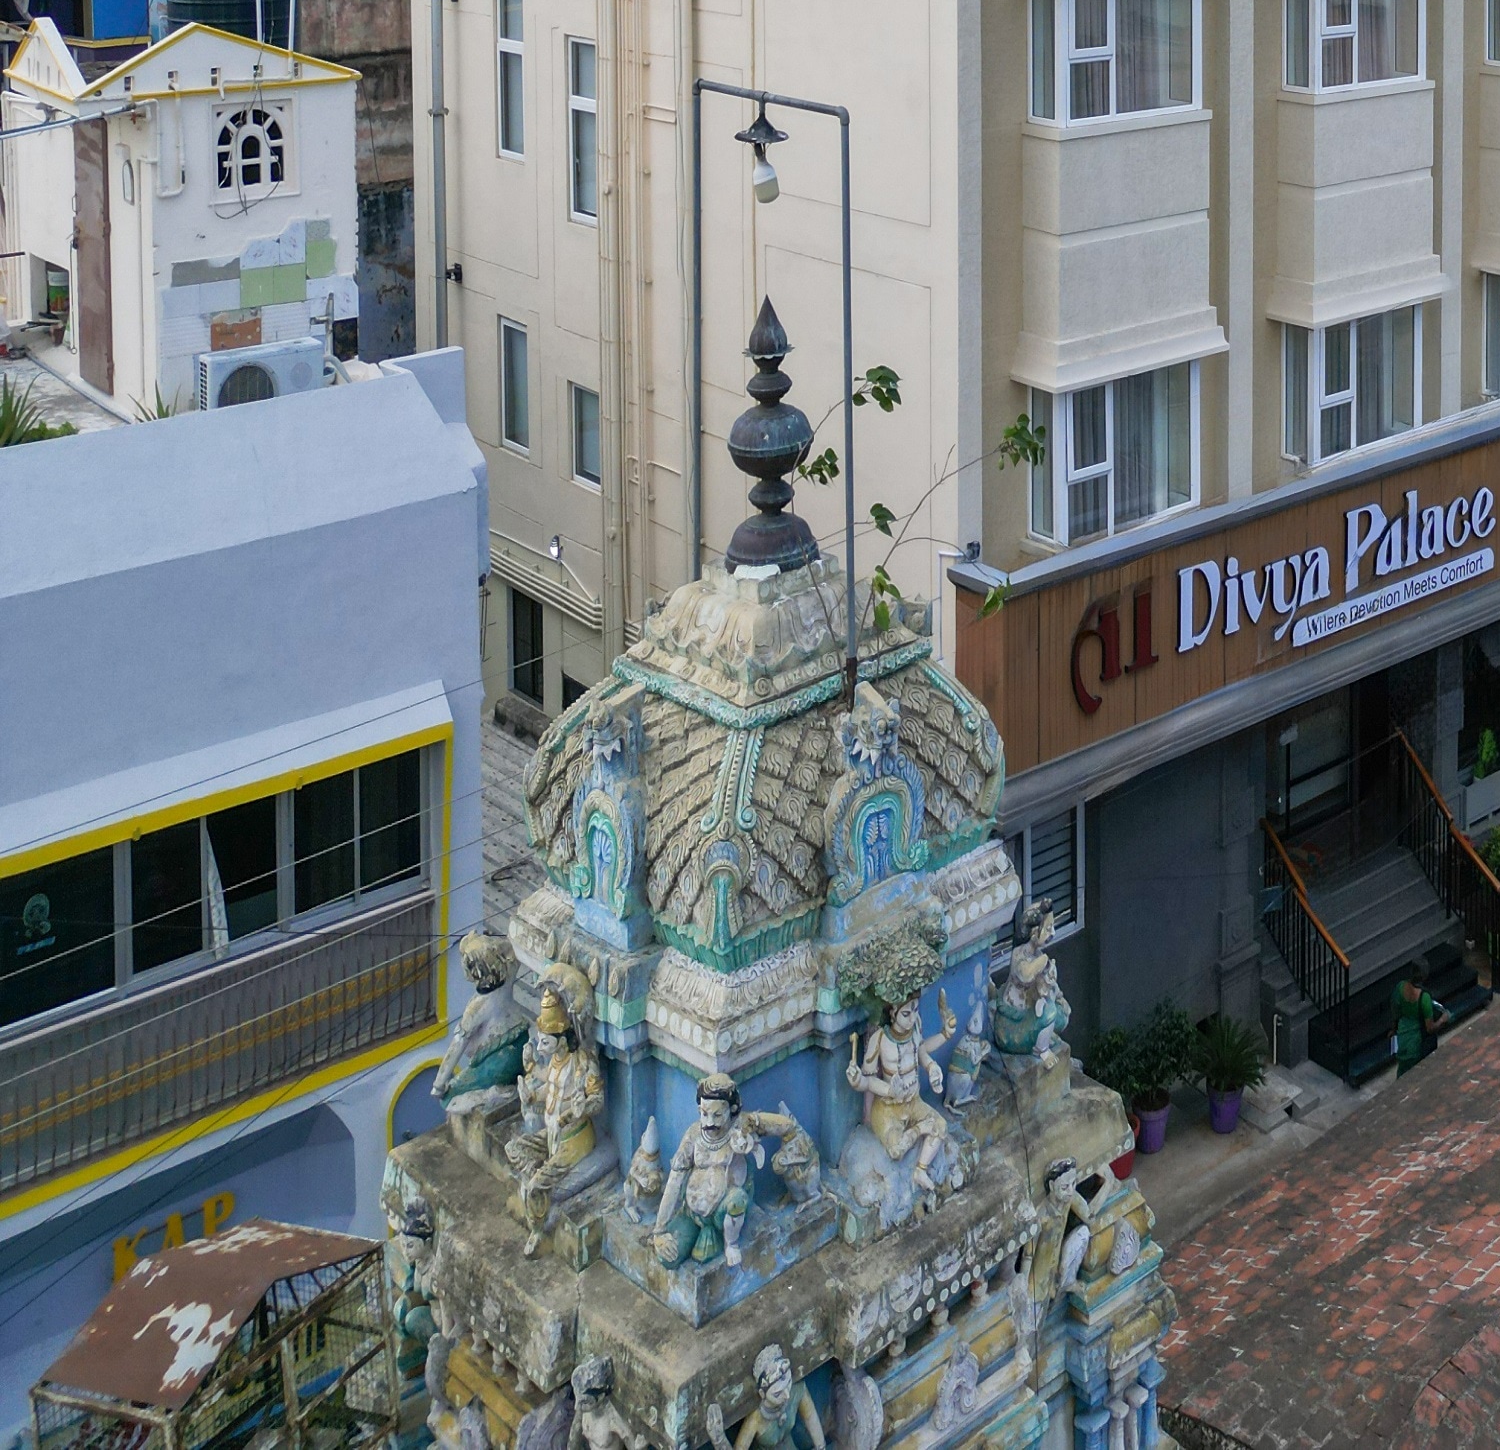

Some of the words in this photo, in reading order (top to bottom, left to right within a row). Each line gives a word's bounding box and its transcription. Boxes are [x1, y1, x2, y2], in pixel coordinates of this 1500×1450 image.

[1177, 546, 1331, 654] Divya
[1345, 486, 1497, 594] Palace
[1403, 579, 1438, 600] Meets
[1440, 554, 1484, 585] Comfort
